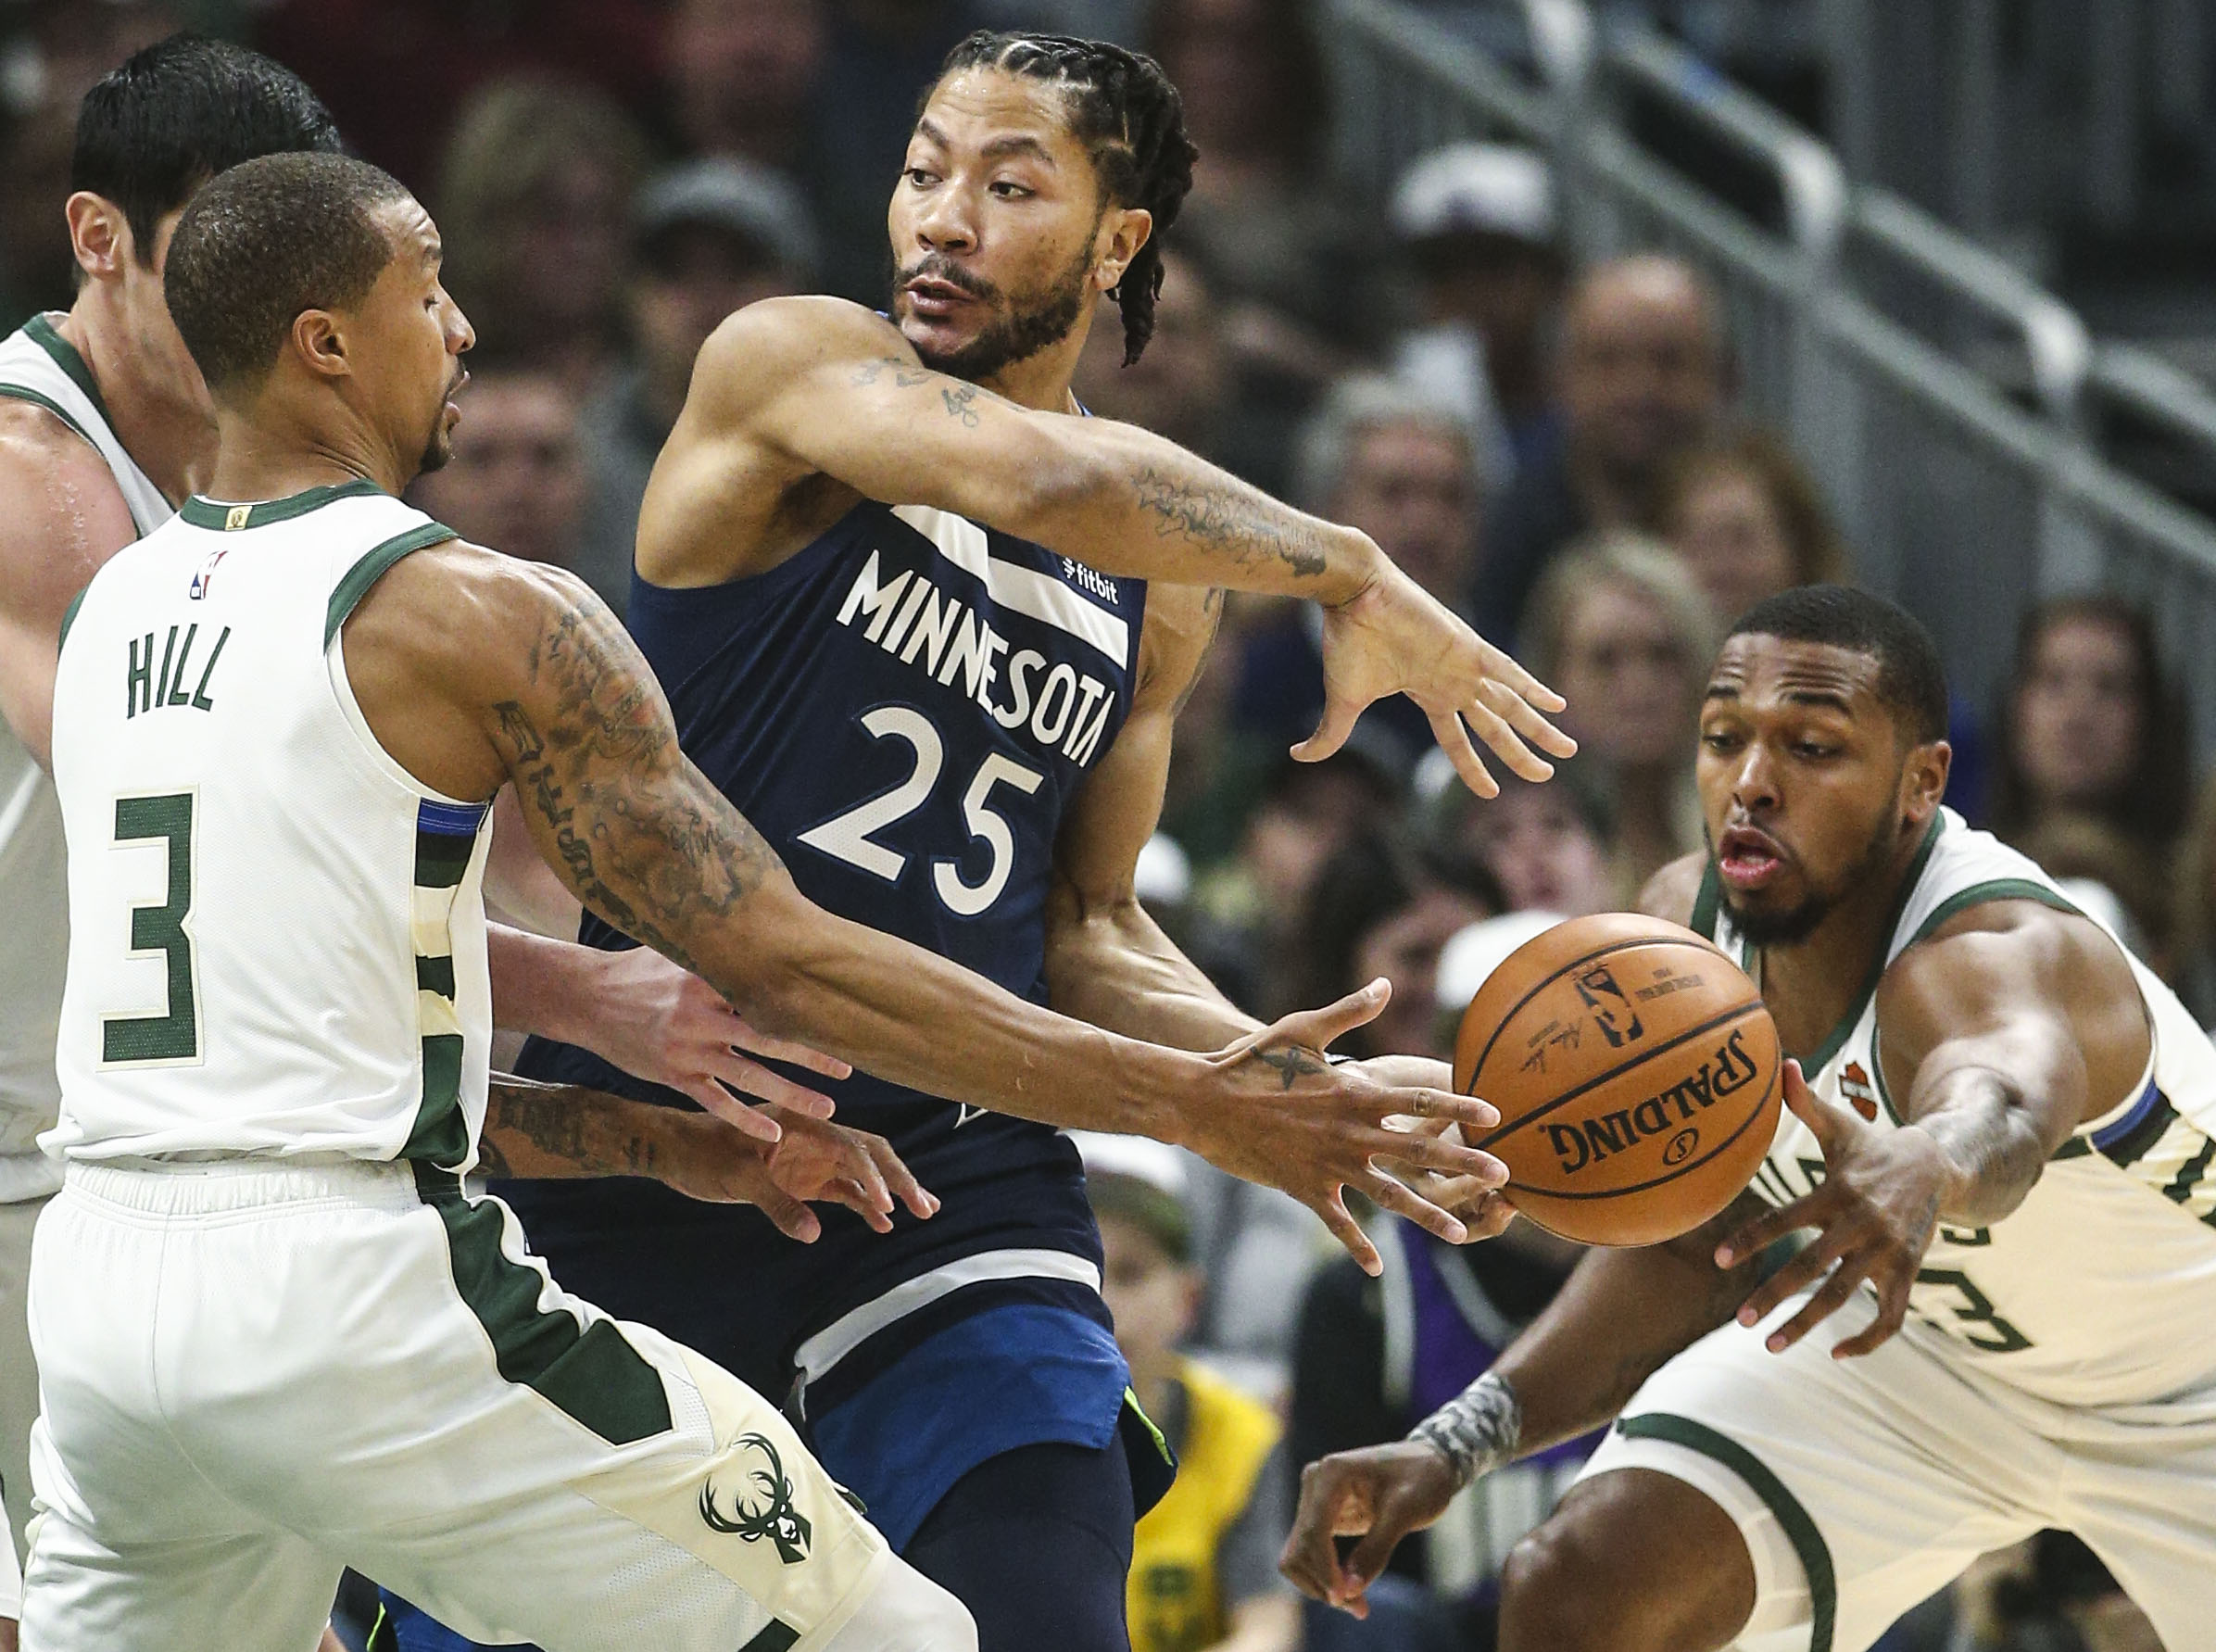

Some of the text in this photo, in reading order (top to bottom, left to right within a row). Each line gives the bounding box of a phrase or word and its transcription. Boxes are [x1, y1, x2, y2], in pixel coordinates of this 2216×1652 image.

[127, 624, 231, 719] HILL
[837, 549, 1114, 767] MINNESOTA
[1077, 562, 1118, 605] fitbit
[797, 706, 1044, 915] 25
[100, 790, 199, 1065] 3
[1547, 1028, 1757, 1175] SPALDING
